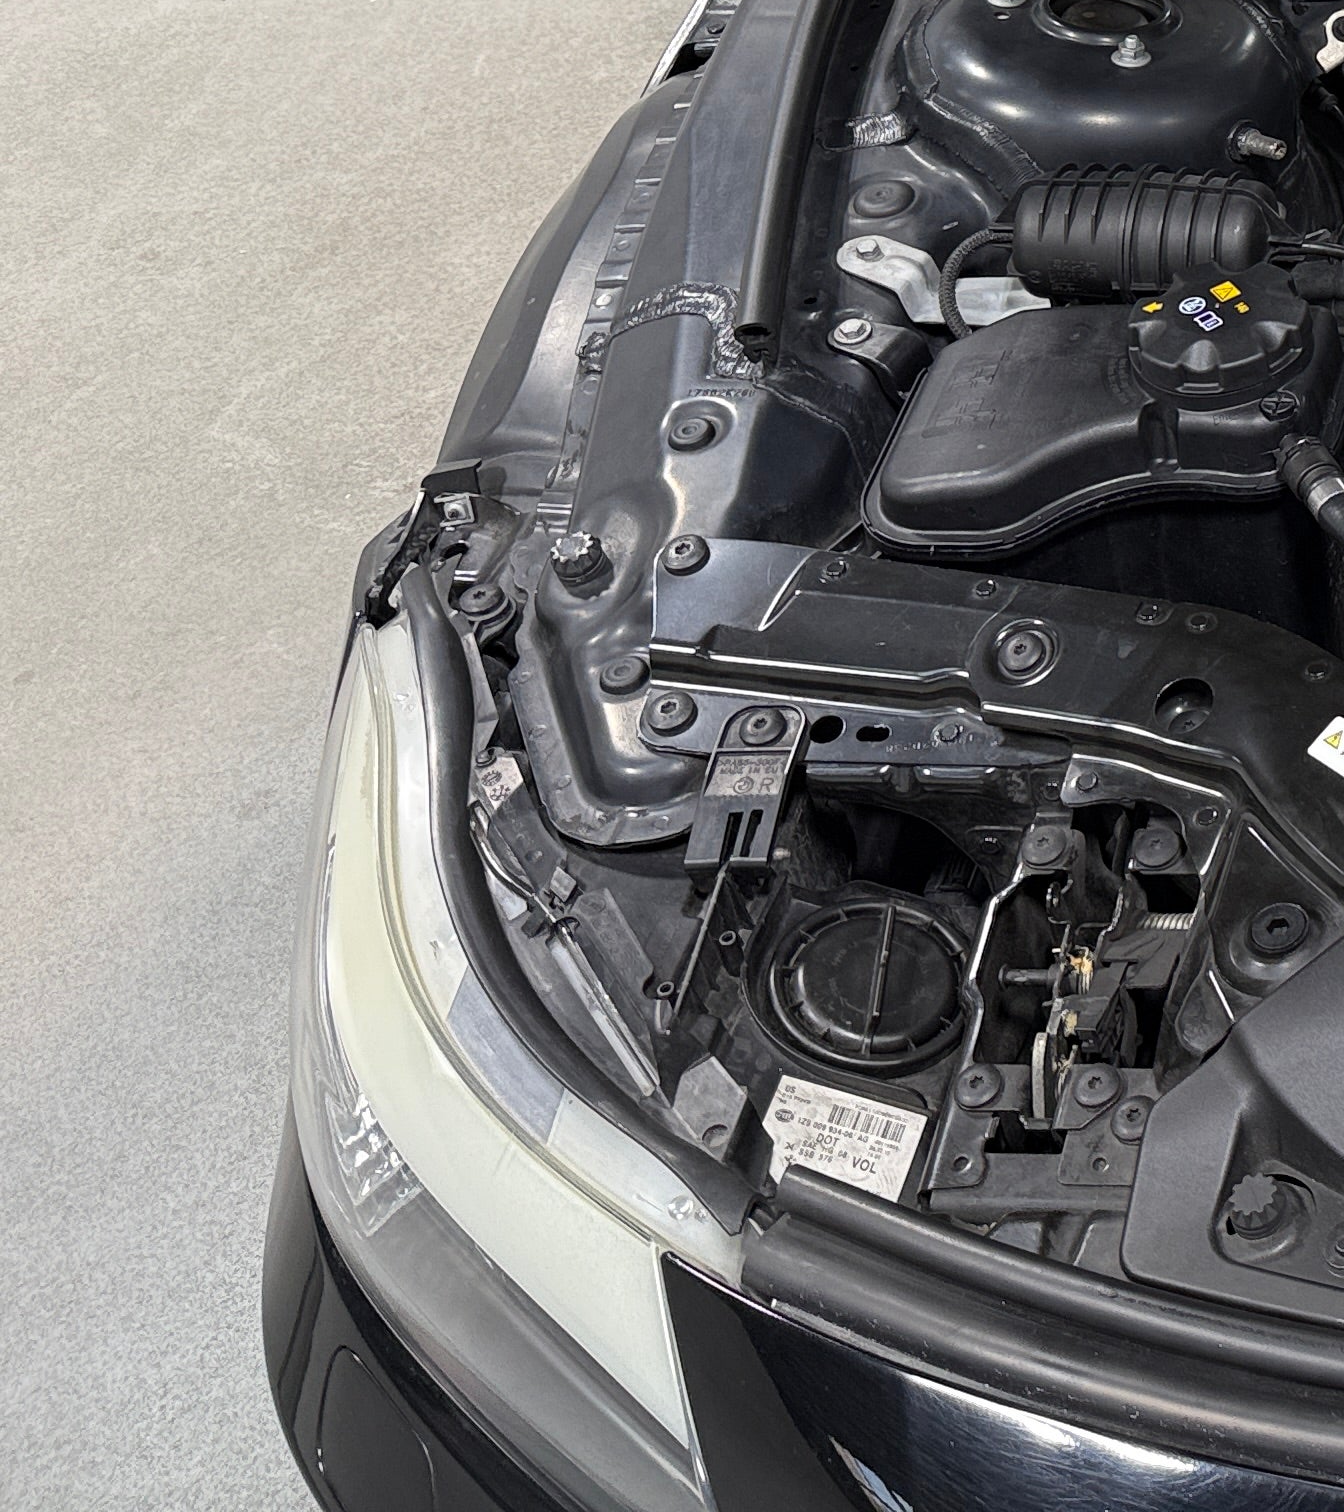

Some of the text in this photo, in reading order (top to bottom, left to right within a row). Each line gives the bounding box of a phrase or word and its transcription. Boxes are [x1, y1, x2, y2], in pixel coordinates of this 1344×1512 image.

[758, 777, 775, 793] R
[801, 1139, 817, 1149] SAE
[815, 1132, 840, 1146] DOT
[852, 1155, 877, 1174] VOL
